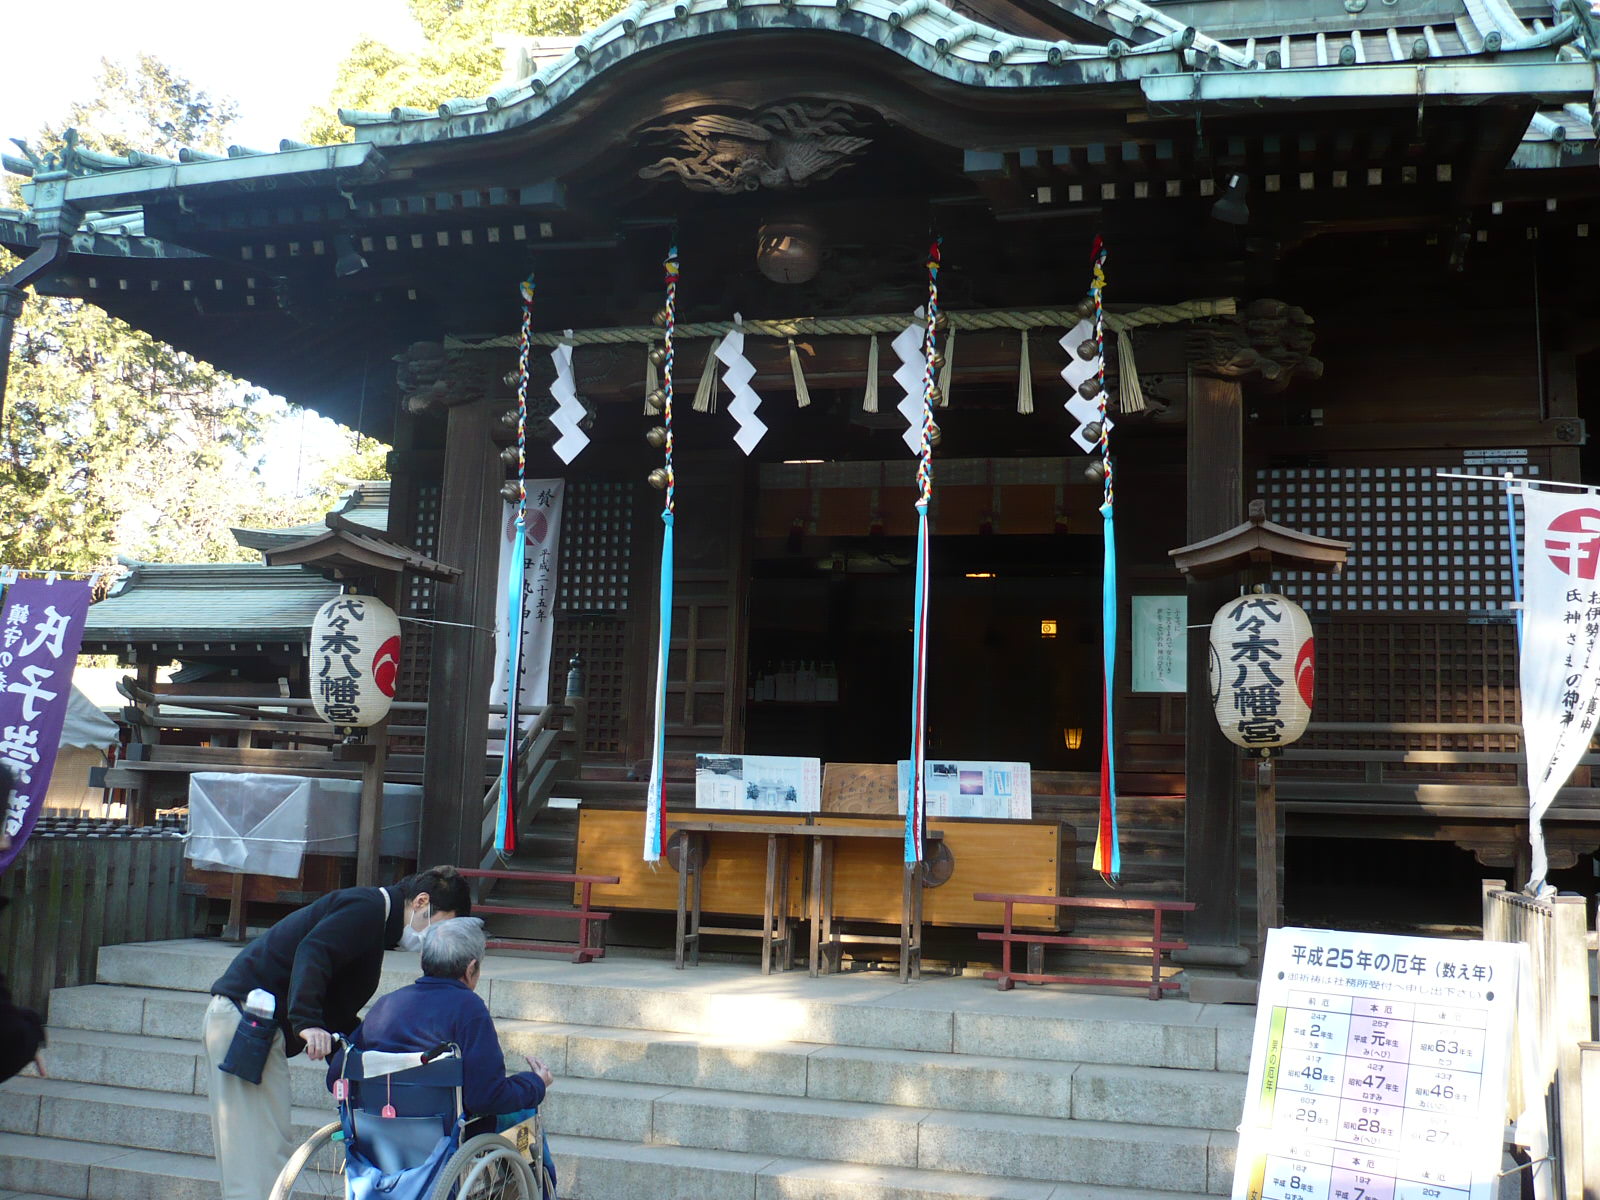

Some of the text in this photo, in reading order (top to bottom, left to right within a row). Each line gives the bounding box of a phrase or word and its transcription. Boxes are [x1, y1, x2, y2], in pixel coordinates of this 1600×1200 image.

[535, 547, 551, 623] 平成二十五年
[319, 599, 365, 723] 代々木八幡宮
[1227, 598, 1285, 743] 代々木八幡宮
[1287, 1066, 1335, 1083] 昭和48年生
[1348, 1074, 1399, 1092] 昭和47年生
